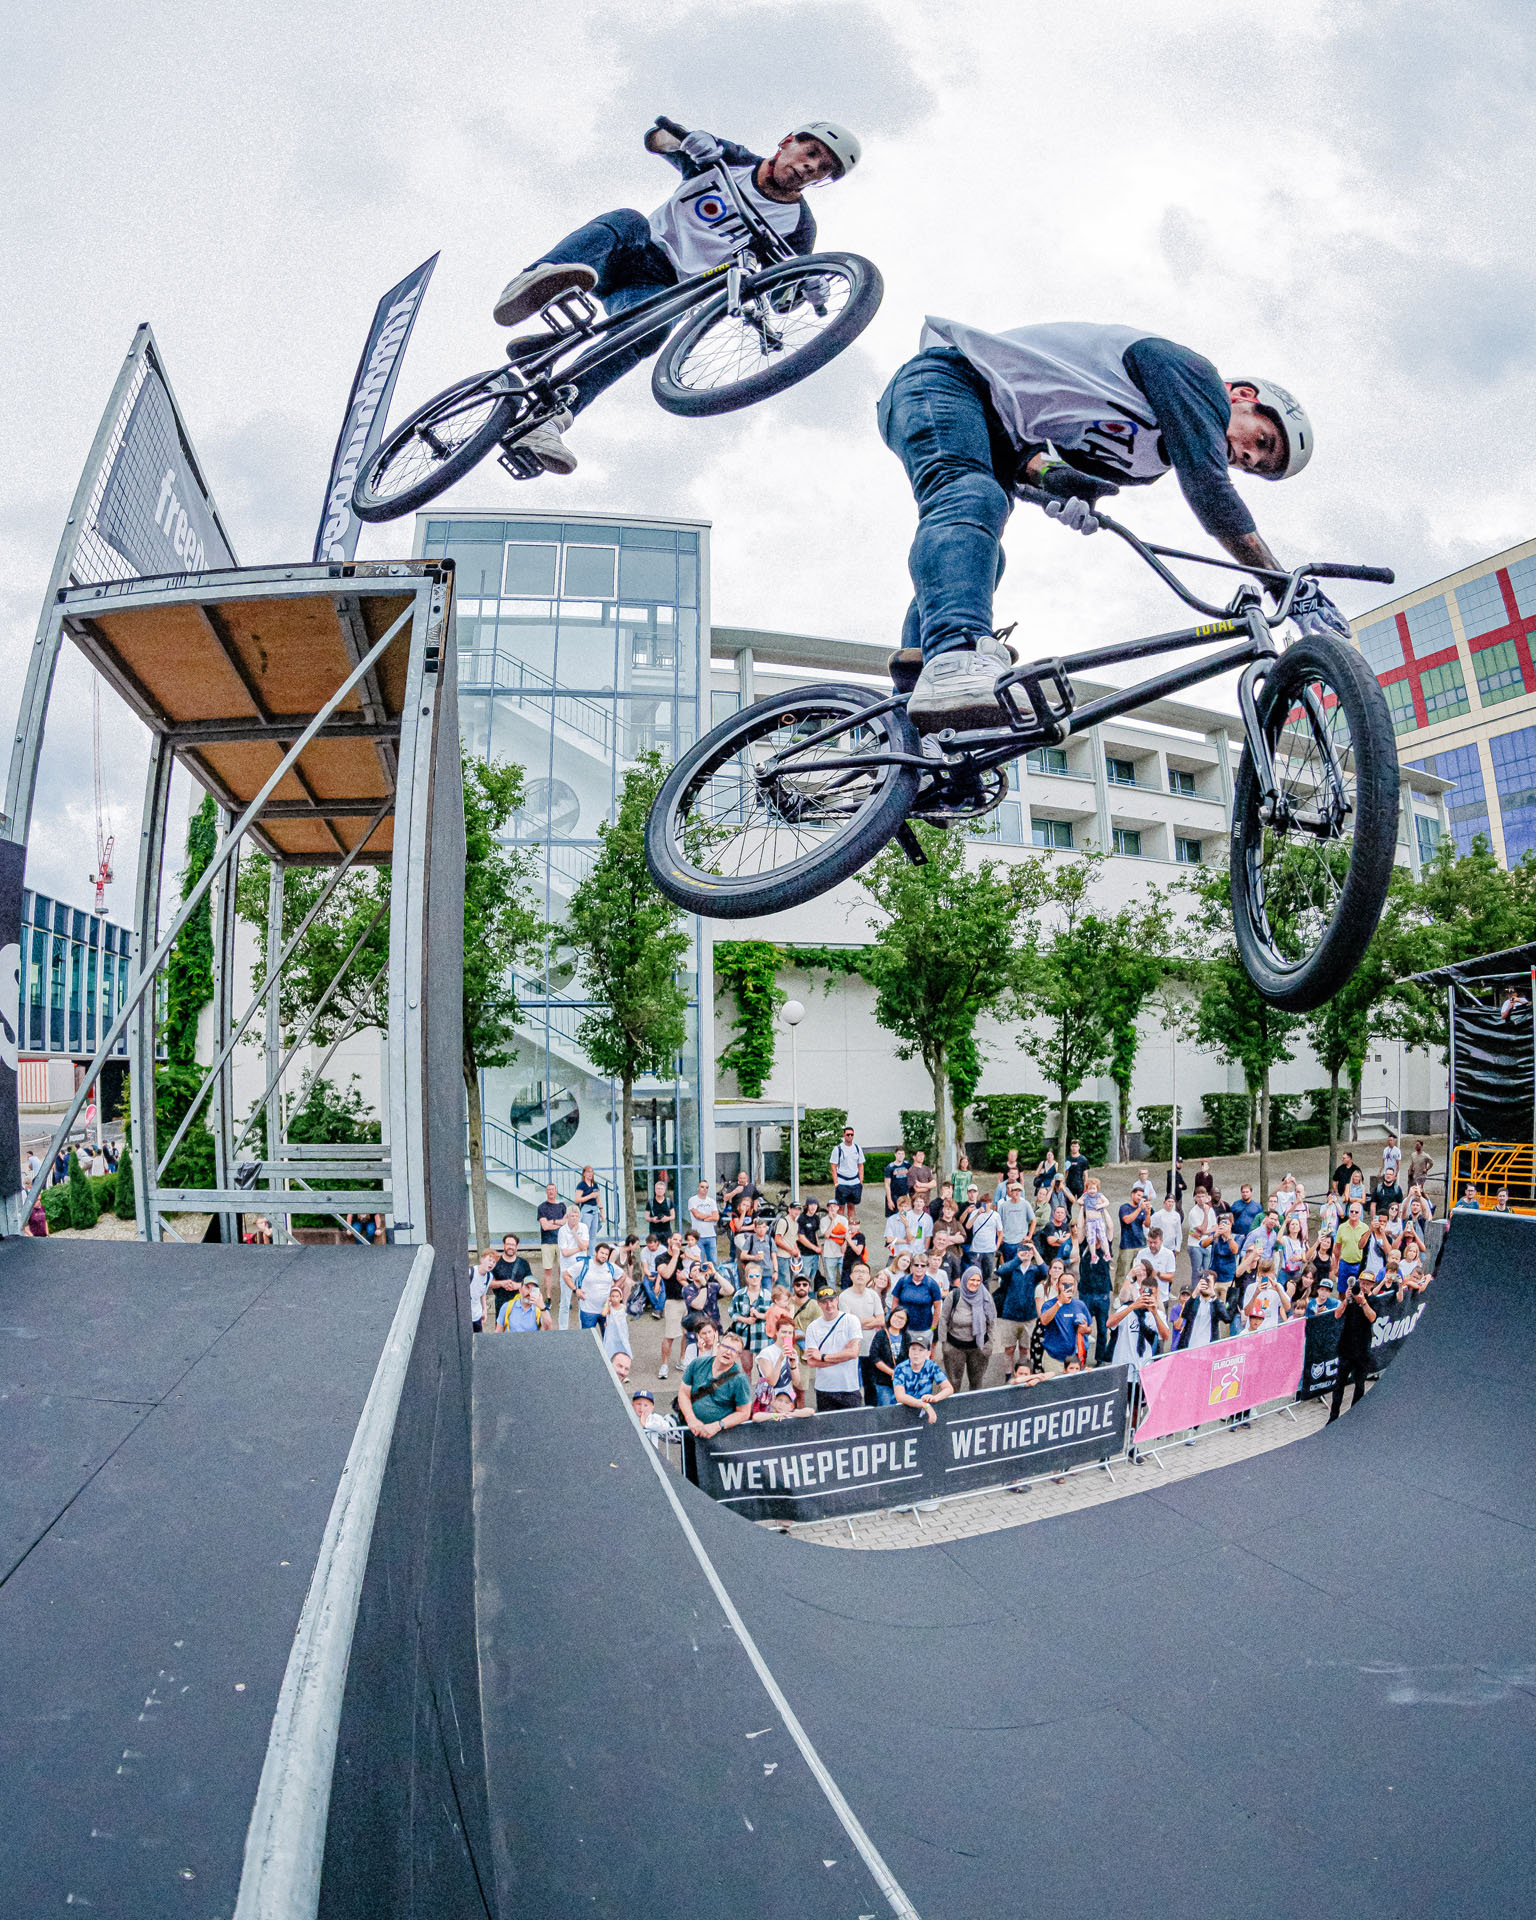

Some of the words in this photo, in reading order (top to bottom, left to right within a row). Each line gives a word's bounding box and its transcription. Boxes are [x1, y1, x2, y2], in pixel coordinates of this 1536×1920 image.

[680, 181, 761, 257] TOTA
[1195, 618, 1236, 637] TOTAL
[1213, 1355, 1245, 1371] EUROBIKE
[951, 1400, 1116, 1459] WETHEPEOPLE
[717, 1438, 918, 1491] WETHEPEOPLE
